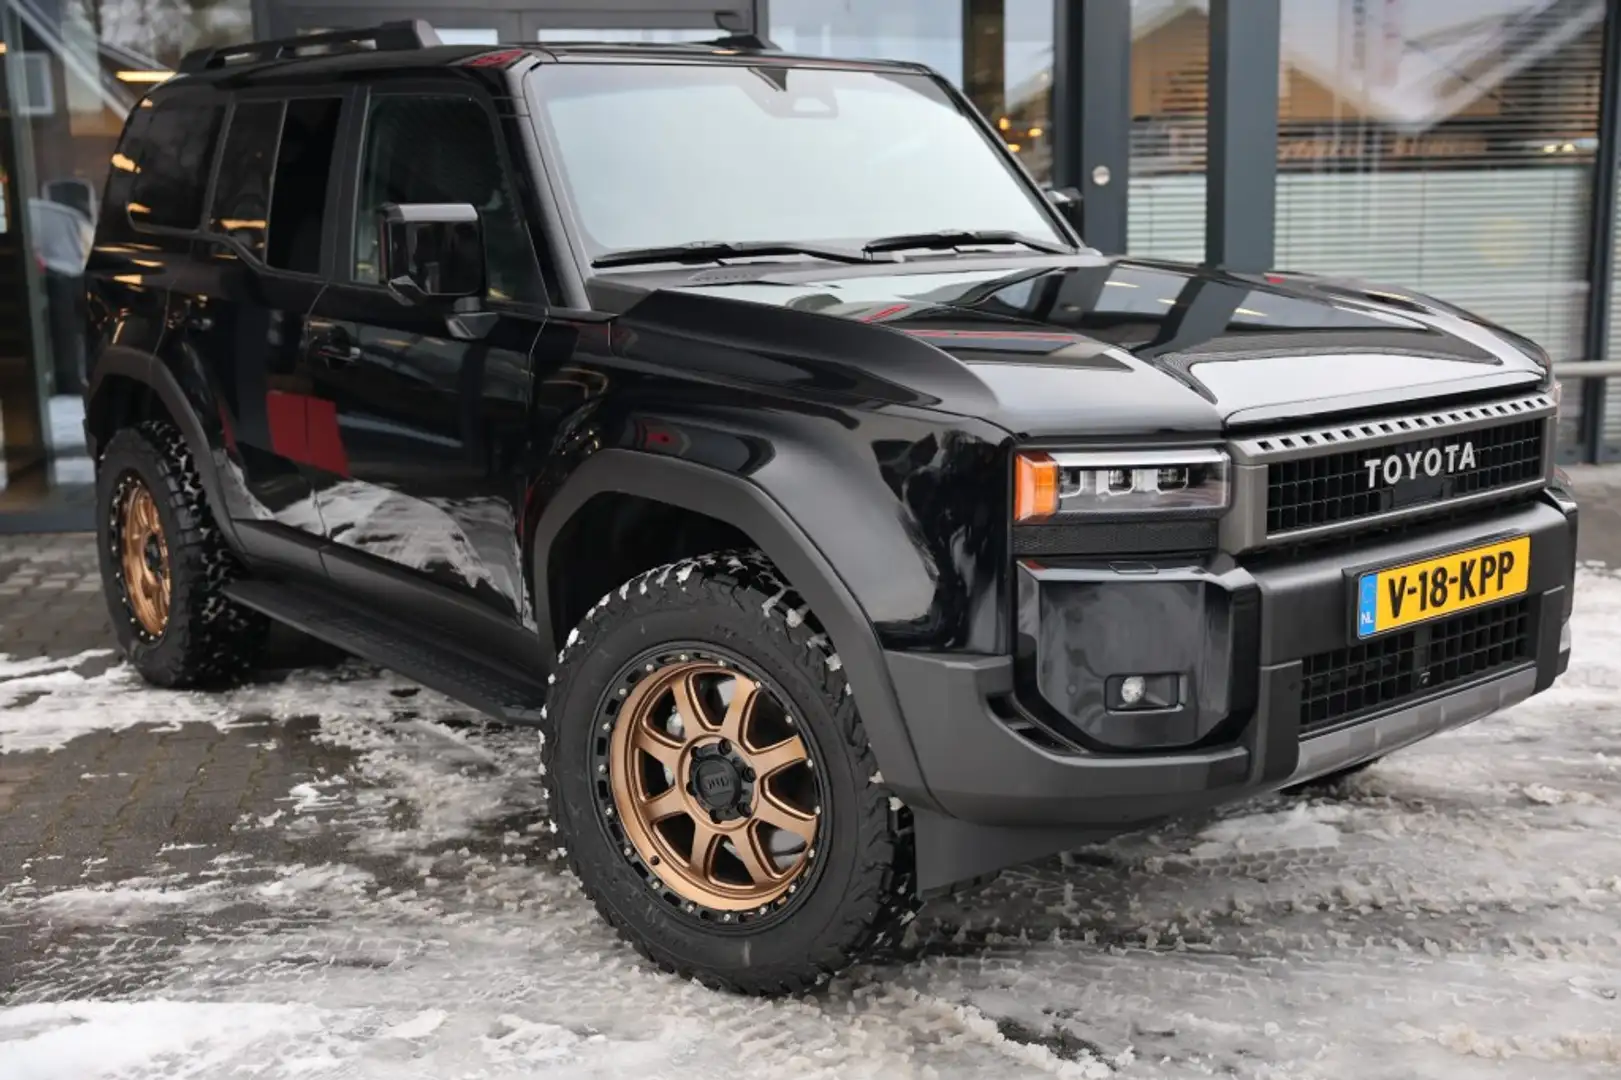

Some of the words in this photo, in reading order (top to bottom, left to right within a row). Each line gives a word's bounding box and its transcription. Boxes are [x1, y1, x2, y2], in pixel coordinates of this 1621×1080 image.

[1364, 442, 1476, 488] TOYOTA
[1388, 551, 1514, 618] V-18-KPP
[1361, 612, 1374, 625] NL
